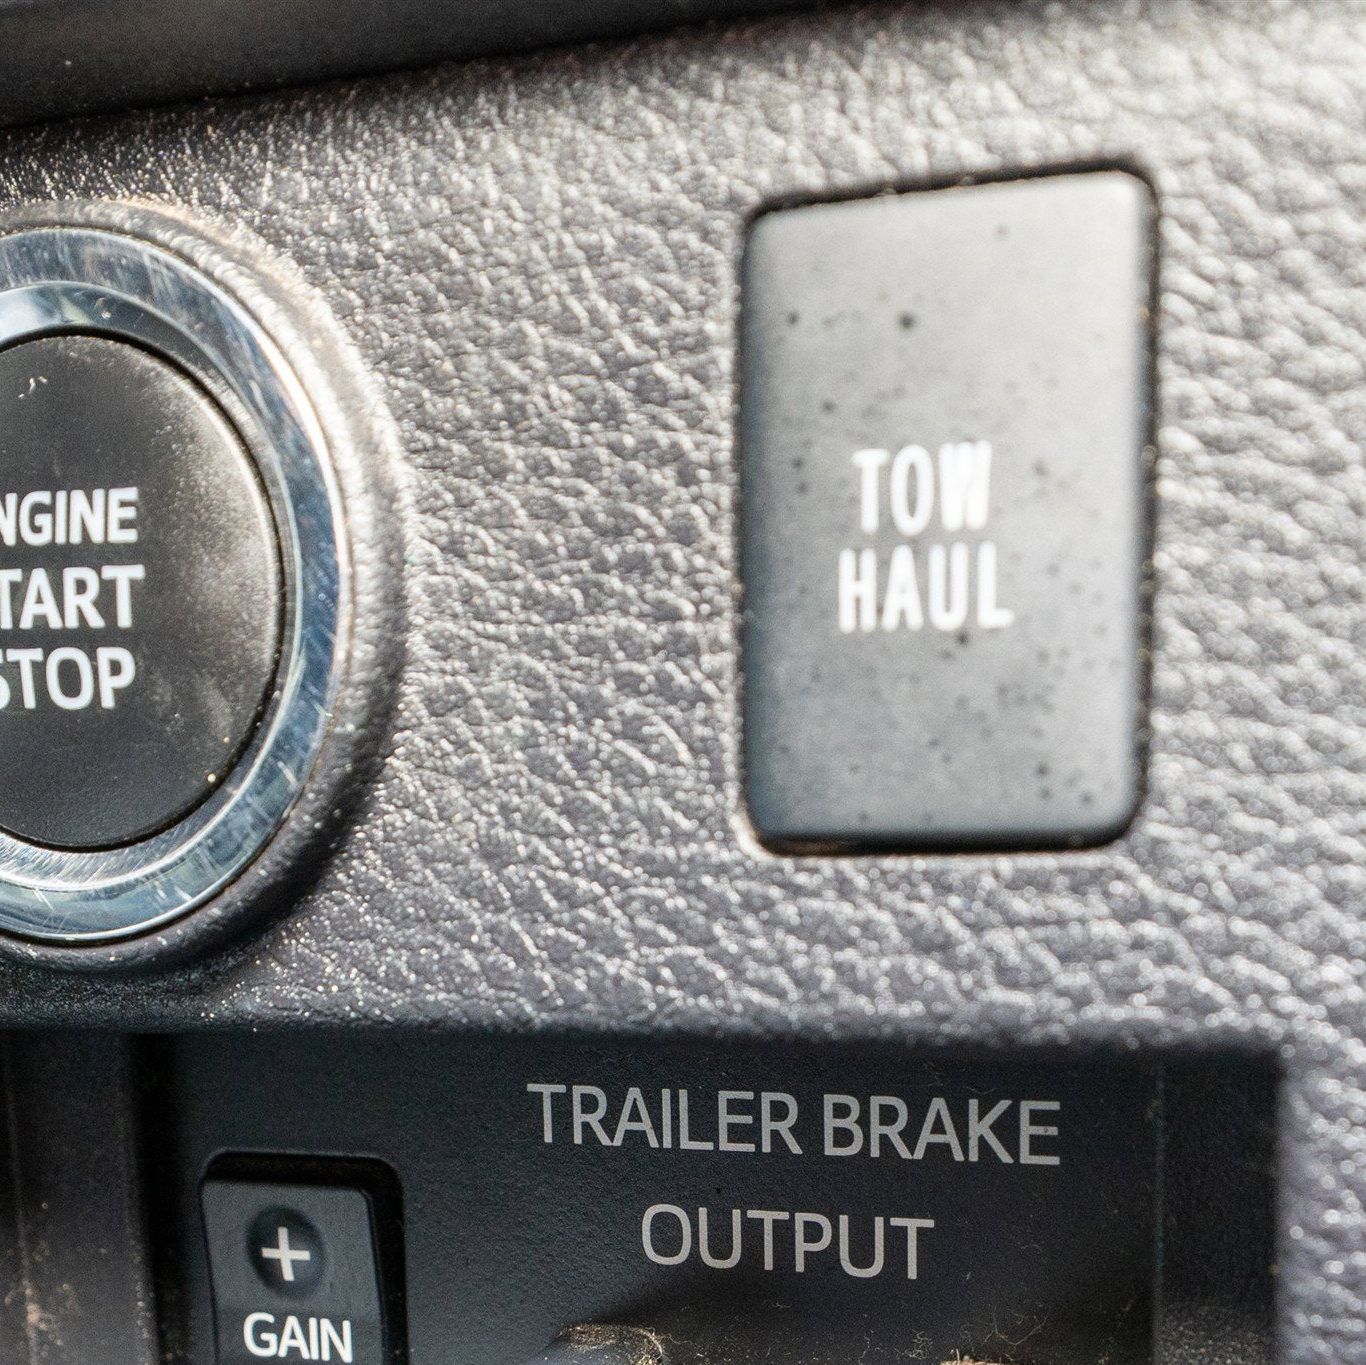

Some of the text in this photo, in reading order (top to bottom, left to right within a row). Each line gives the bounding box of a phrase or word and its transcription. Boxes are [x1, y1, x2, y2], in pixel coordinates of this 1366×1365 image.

[850, 441, 993, 535] TOW
[838, 543, 1014, 634] HAUL
[526, 1083, 1062, 1166] TRAILER BRAKE
[641, 1203, 935, 1280] OUTPUT
[243, 1311, 353, 1364] GAIN
